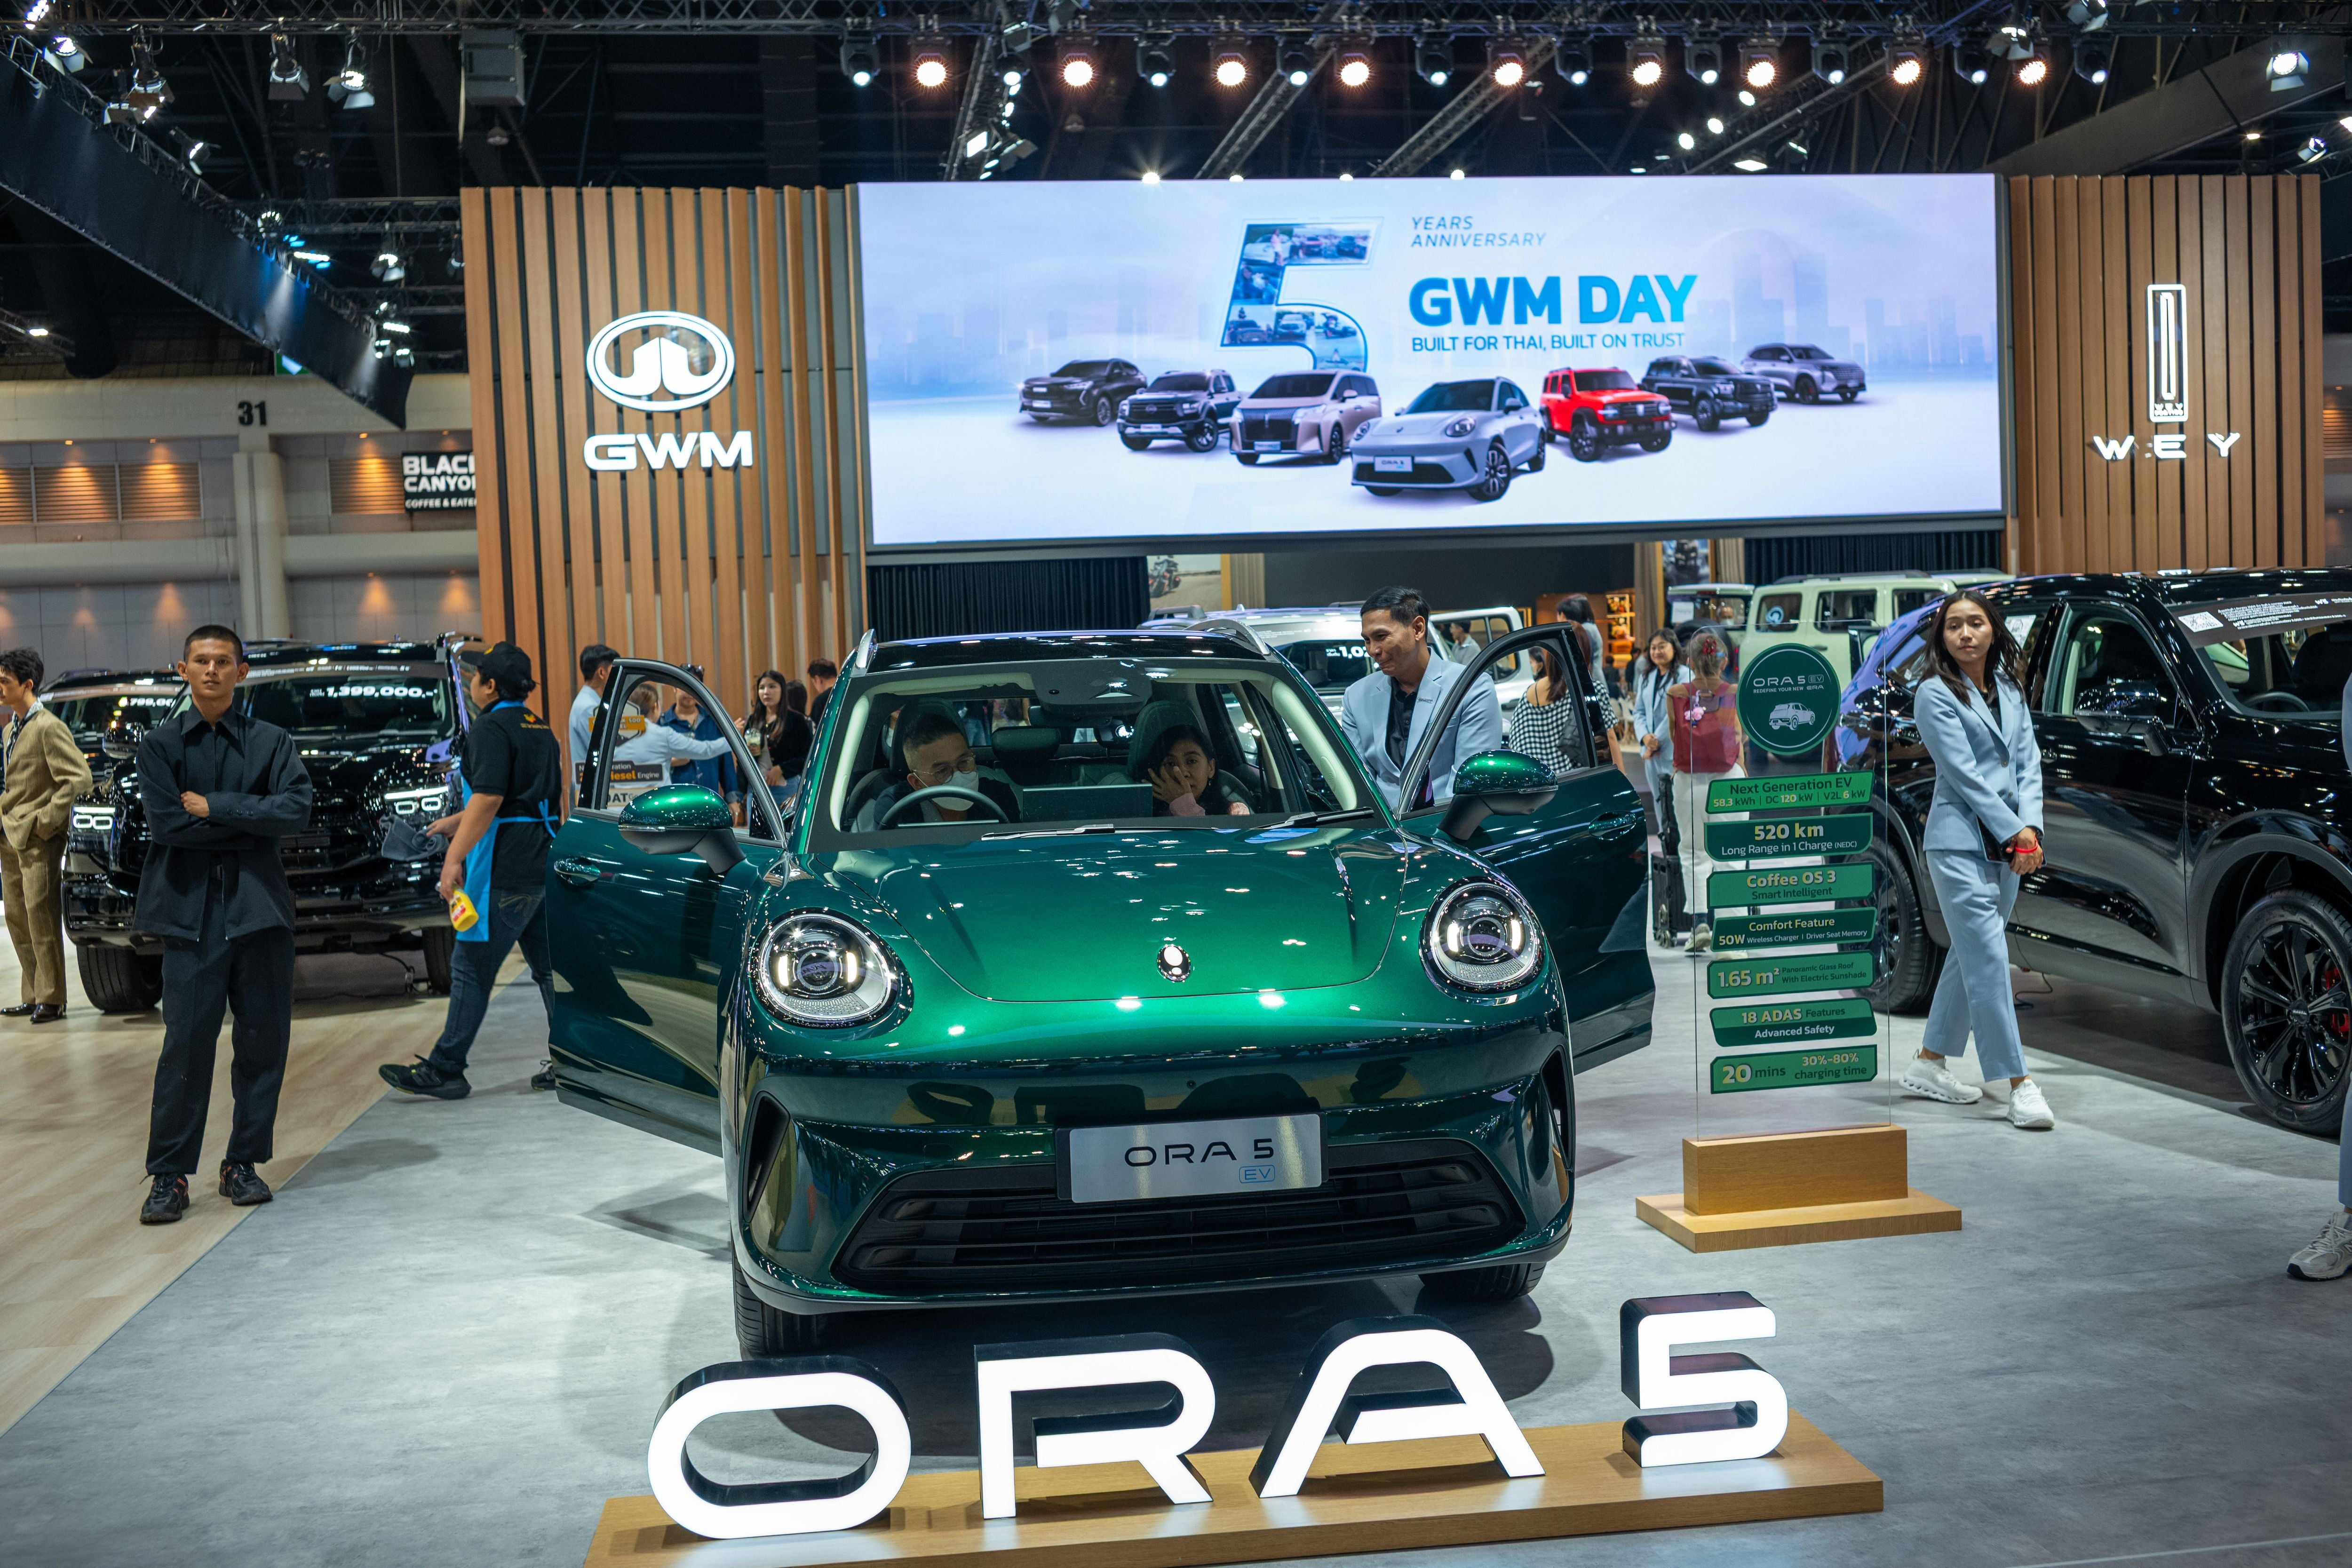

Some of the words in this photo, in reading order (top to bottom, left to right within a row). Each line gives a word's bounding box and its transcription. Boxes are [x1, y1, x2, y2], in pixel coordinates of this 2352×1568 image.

[1411, 216, 1473, 230] YEARS
[1411, 232, 1546, 247] ANNIVERSARY
[1409, 276, 1562, 326] GWM
[1578, 274, 1698, 324] DAY
[1412, 336, 1458, 351] BUILT
[1464, 336, 1498, 350] FOR
[1502, 335, 1547, 351] THAI,
[1552, 334, 1597, 349] BUILT
[1602, 334, 1626, 348] ON
[1631, 333, 1685, 347] TRUST
[238, 400, 267, 426] 31
[584, 430, 753, 471] GWM
[2093, 432, 2240, 460] WEY
[405, 498, 441, 509] COFFEE
[450, 497, 477, 508] EATE
[1753, 677, 1794, 687] ORA
[1797, 676, 1805, 684] 5
[610, 771, 636, 780] iesel
[1730, 783, 1759, 795] Next
[1762, 779, 1832, 792] Generation
[1836, 777, 1852, 788] EV
[1713, 798, 1733, 807] 58.3
[1735, 796, 1755, 805] kWh
[1765, 795, 1779, 804] DC
[1780, 794, 1796, 803] 120
[1799, 793, 1813, 802] kW
[1823, 792, 1842, 800] V2L
[1755, 824, 1790, 841] 520
[1795, 823, 1824, 838] km
[1722, 846, 1746, 856] Long
[1748, 844, 1779, 854] Range
[1781, 843, 1790, 852] in
[1793, 842, 1796, 851] 1
[1798, 841, 1832, 851] Charge
[1747, 873, 1798, 888] Coffee
[1802, 871, 1823, 884] OS
[1827, 870, 1836, 883] 3
[1752, 891, 1781, 900] Smart
[1783, 887, 1833, 898] Intelligent
[1749, 920, 1793, 931] Comfort
[1795, 918, 1835, 928] Feature
[1719, 934, 1745, 946] 50W
[1718, 970, 1752, 987] 1.65
[1801, 974, 1828, 982] Electric
[1830, 971, 1867, 980] Sunshade
[1741, 1012, 1757, 1024] 18
[1761, 1008, 1802, 1023] ADAS
[1805, 1008, 1845, 1018] Features
[1755, 1027, 1802, 1038] Advanced
[1804, 1026, 1835, 1035] Safety
[1802, 1053, 1859, 1066] 30%-80%
[1722, 1064, 1752, 1084] 20
[1755, 1066, 1786, 1078] mins
[1795, 1069, 1841, 1080] charging
[1843, 1067, 1867, 1075] time
[1124, 1141, 1237, 1167] ORA
[1253, 1138, 1274, 1159] 5
[1244, 1168, 1271, 1180] EV
[647, 1322, 1547, 1539] ORA
[1623, 1295, 1788, 1468] 5
